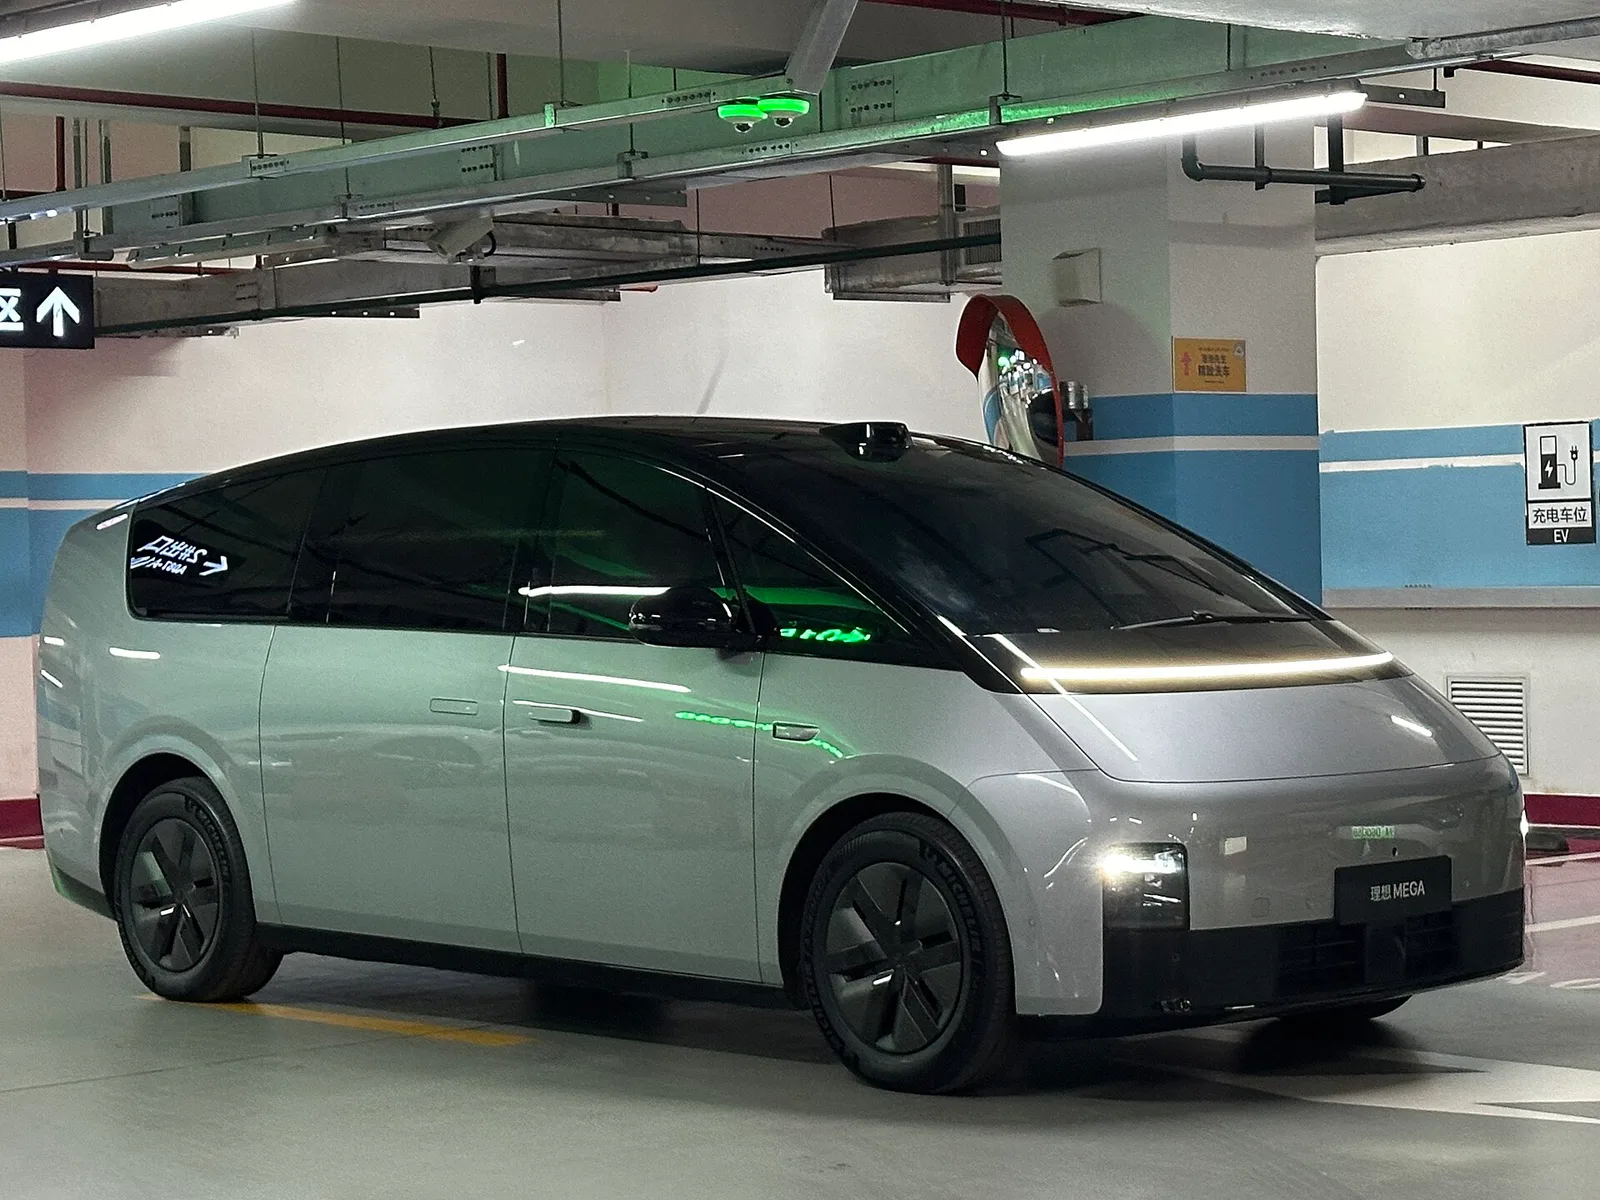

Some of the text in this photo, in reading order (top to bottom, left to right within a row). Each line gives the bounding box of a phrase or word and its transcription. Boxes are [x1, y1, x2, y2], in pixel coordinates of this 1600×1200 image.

[0, 288, 24, 331] 区
[1532, 506, 1588, 524] 充电车位
[1553, 528, 1569, 543] EV
[1370, 880, 1426, 901] 理想 MEGA
